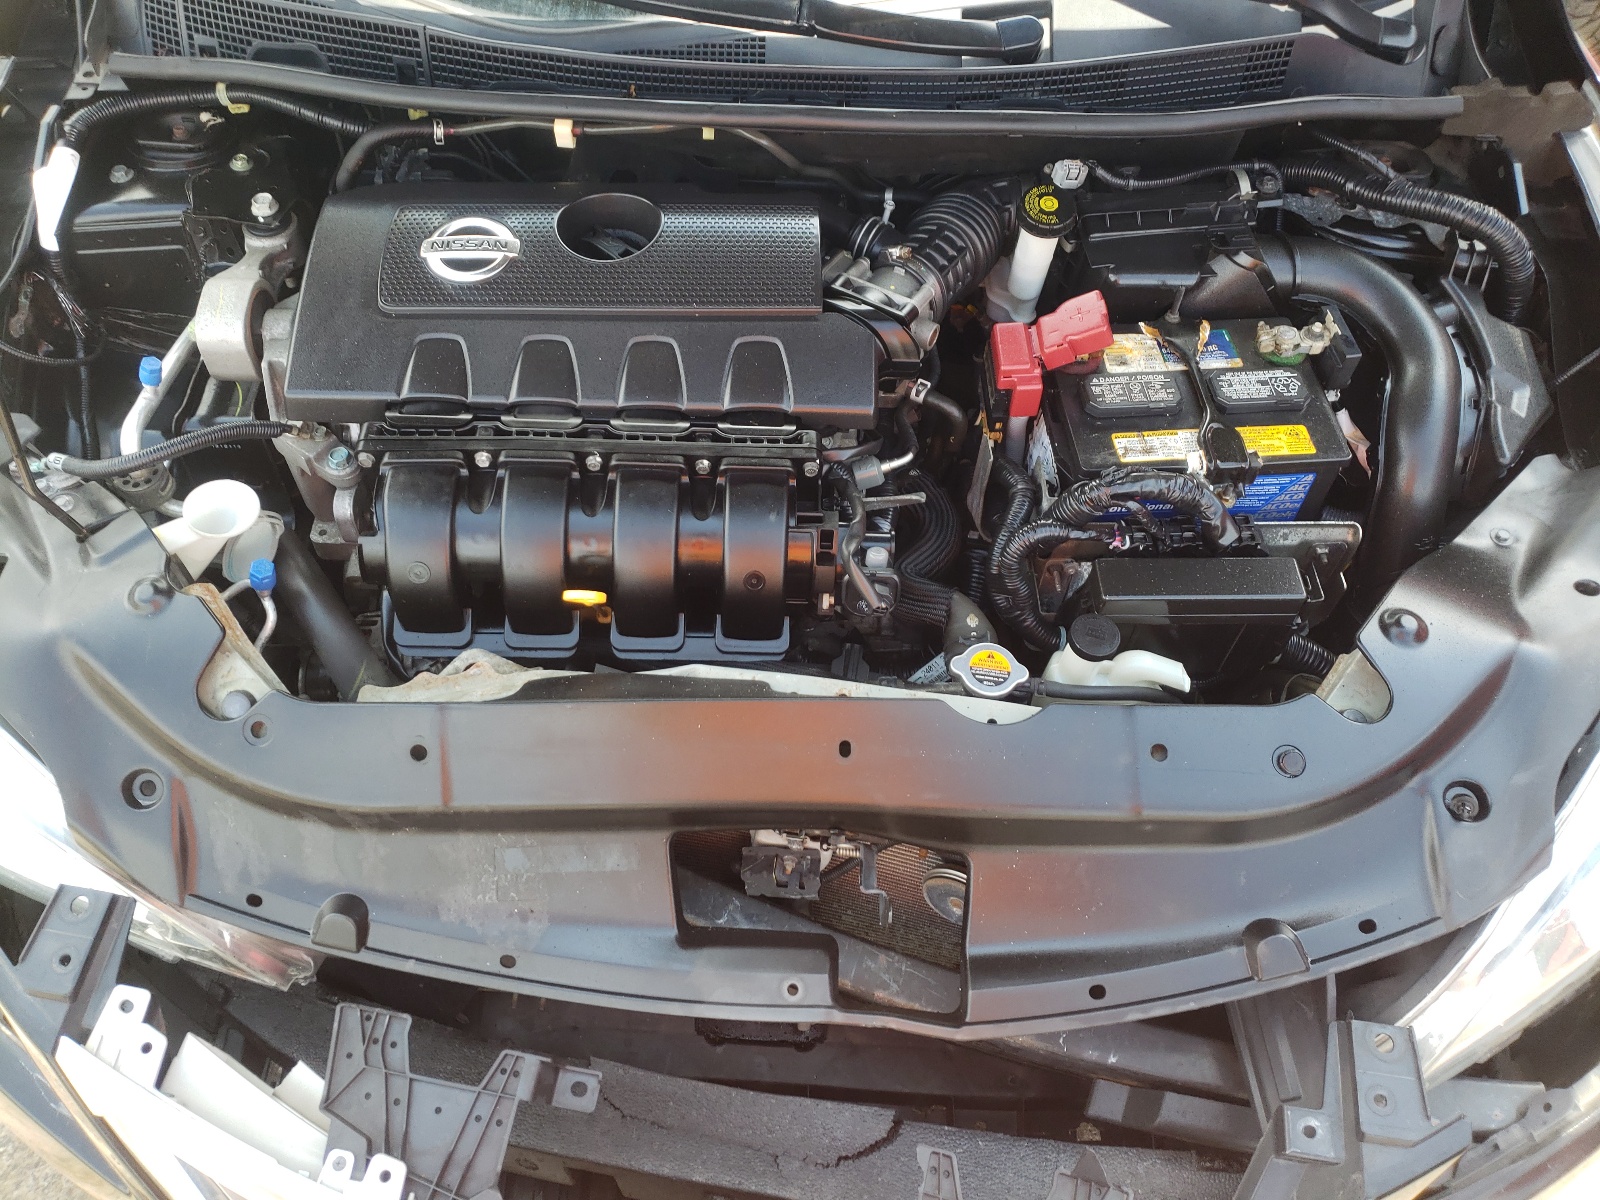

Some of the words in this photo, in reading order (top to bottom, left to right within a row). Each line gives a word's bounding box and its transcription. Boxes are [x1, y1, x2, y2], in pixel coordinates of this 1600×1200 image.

[430, 239, 508, 251] NISSAN
[1099, 375, 1130, 383] DANGER
[978, 657, 1003, 665] WARNING
